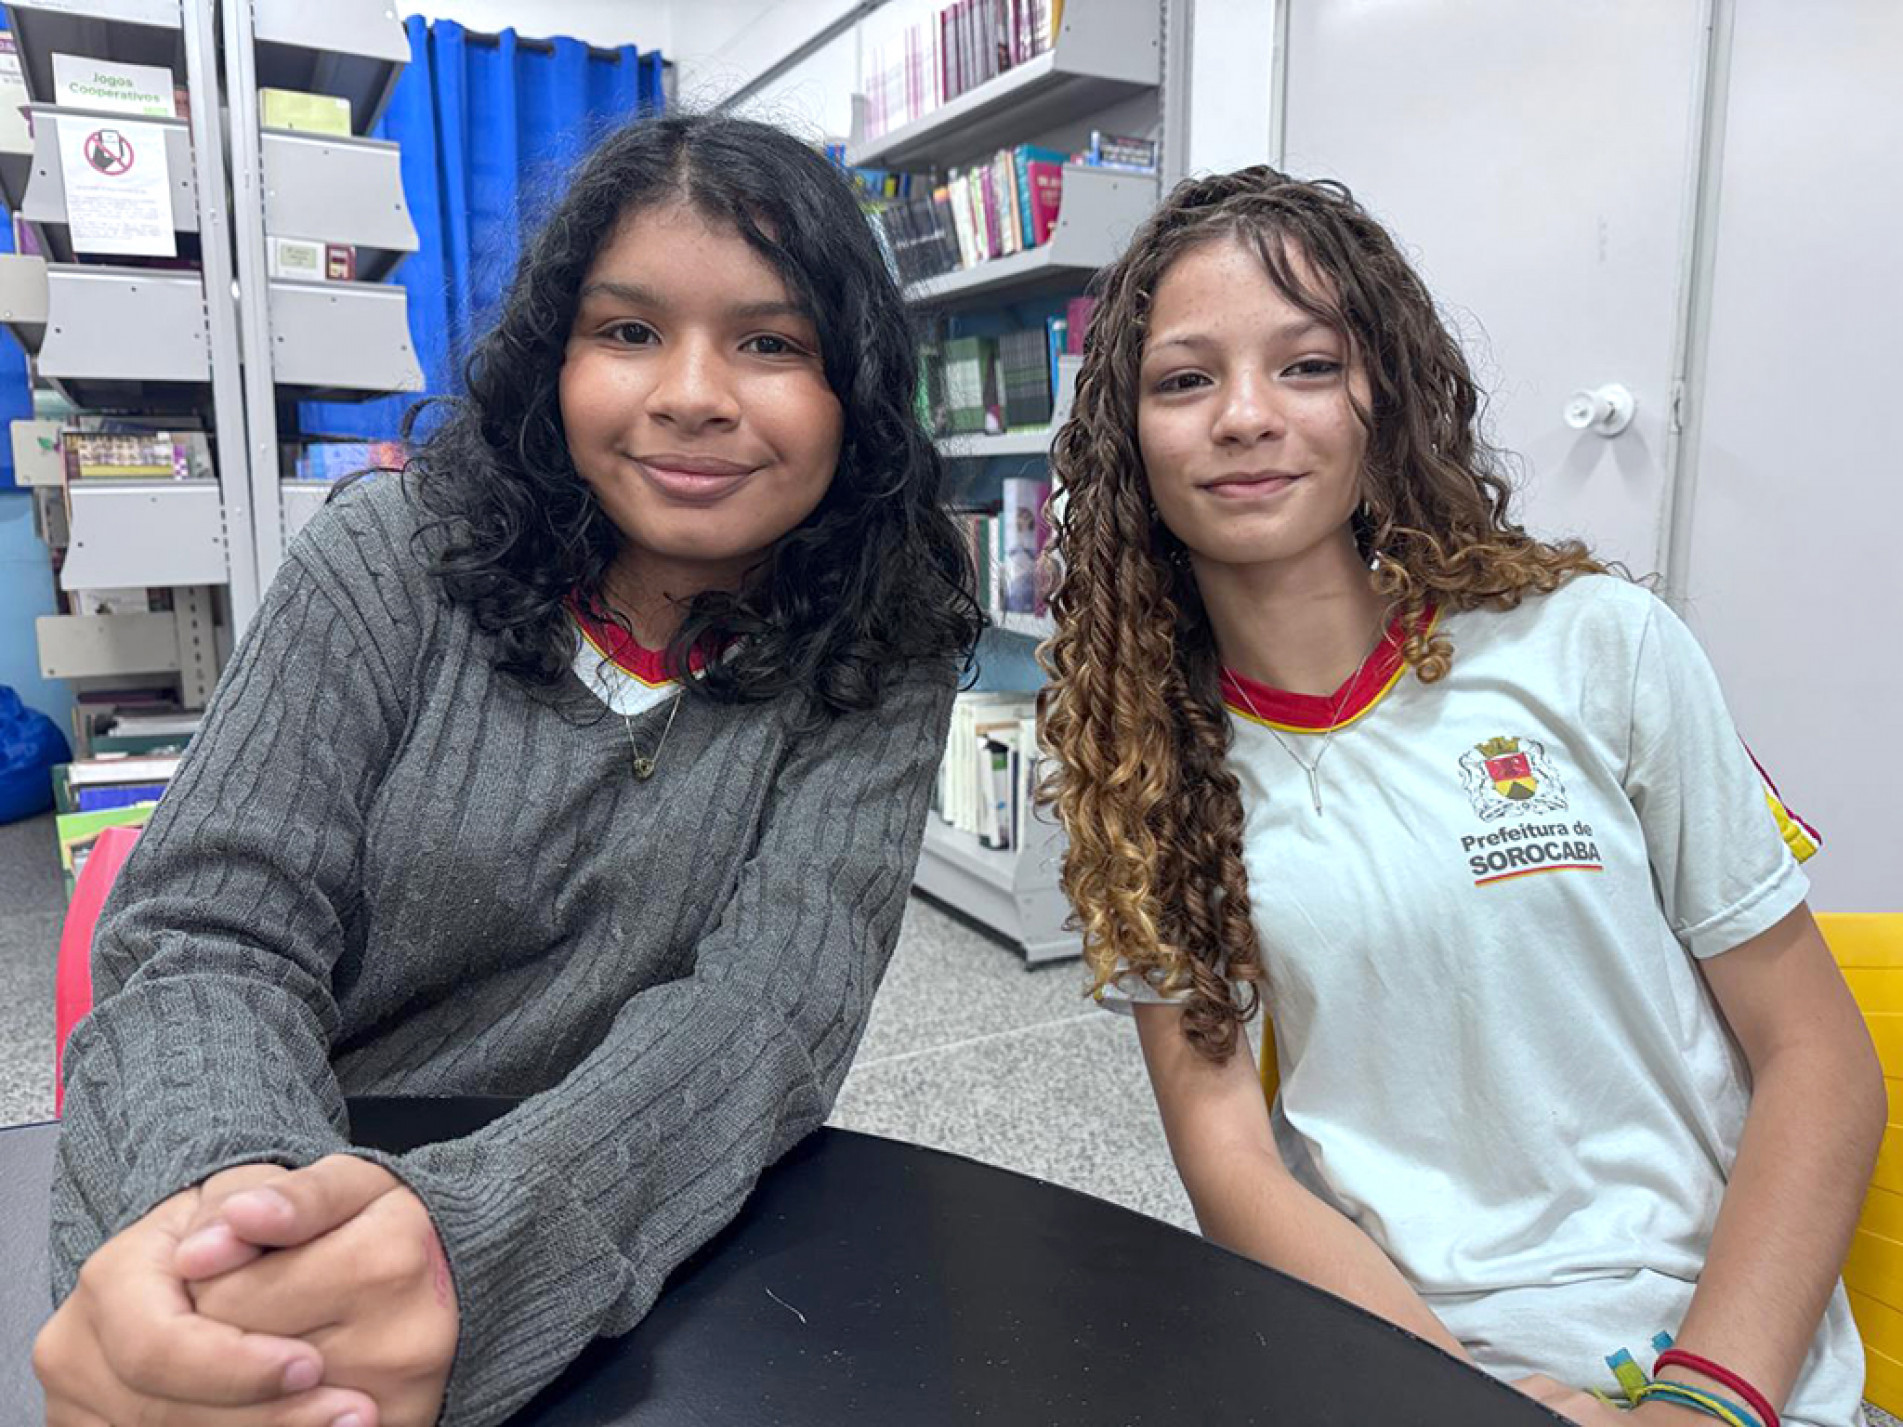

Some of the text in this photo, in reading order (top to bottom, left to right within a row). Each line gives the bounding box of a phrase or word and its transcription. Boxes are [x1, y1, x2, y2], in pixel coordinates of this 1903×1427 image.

[68, 81, 160, 102] Cooperativos
[93, 72, 133, 88] Jogos
[1461, 821, 1593, 851] Prefeitura de
[1469, 841, 1602, 875] SOROCABA
